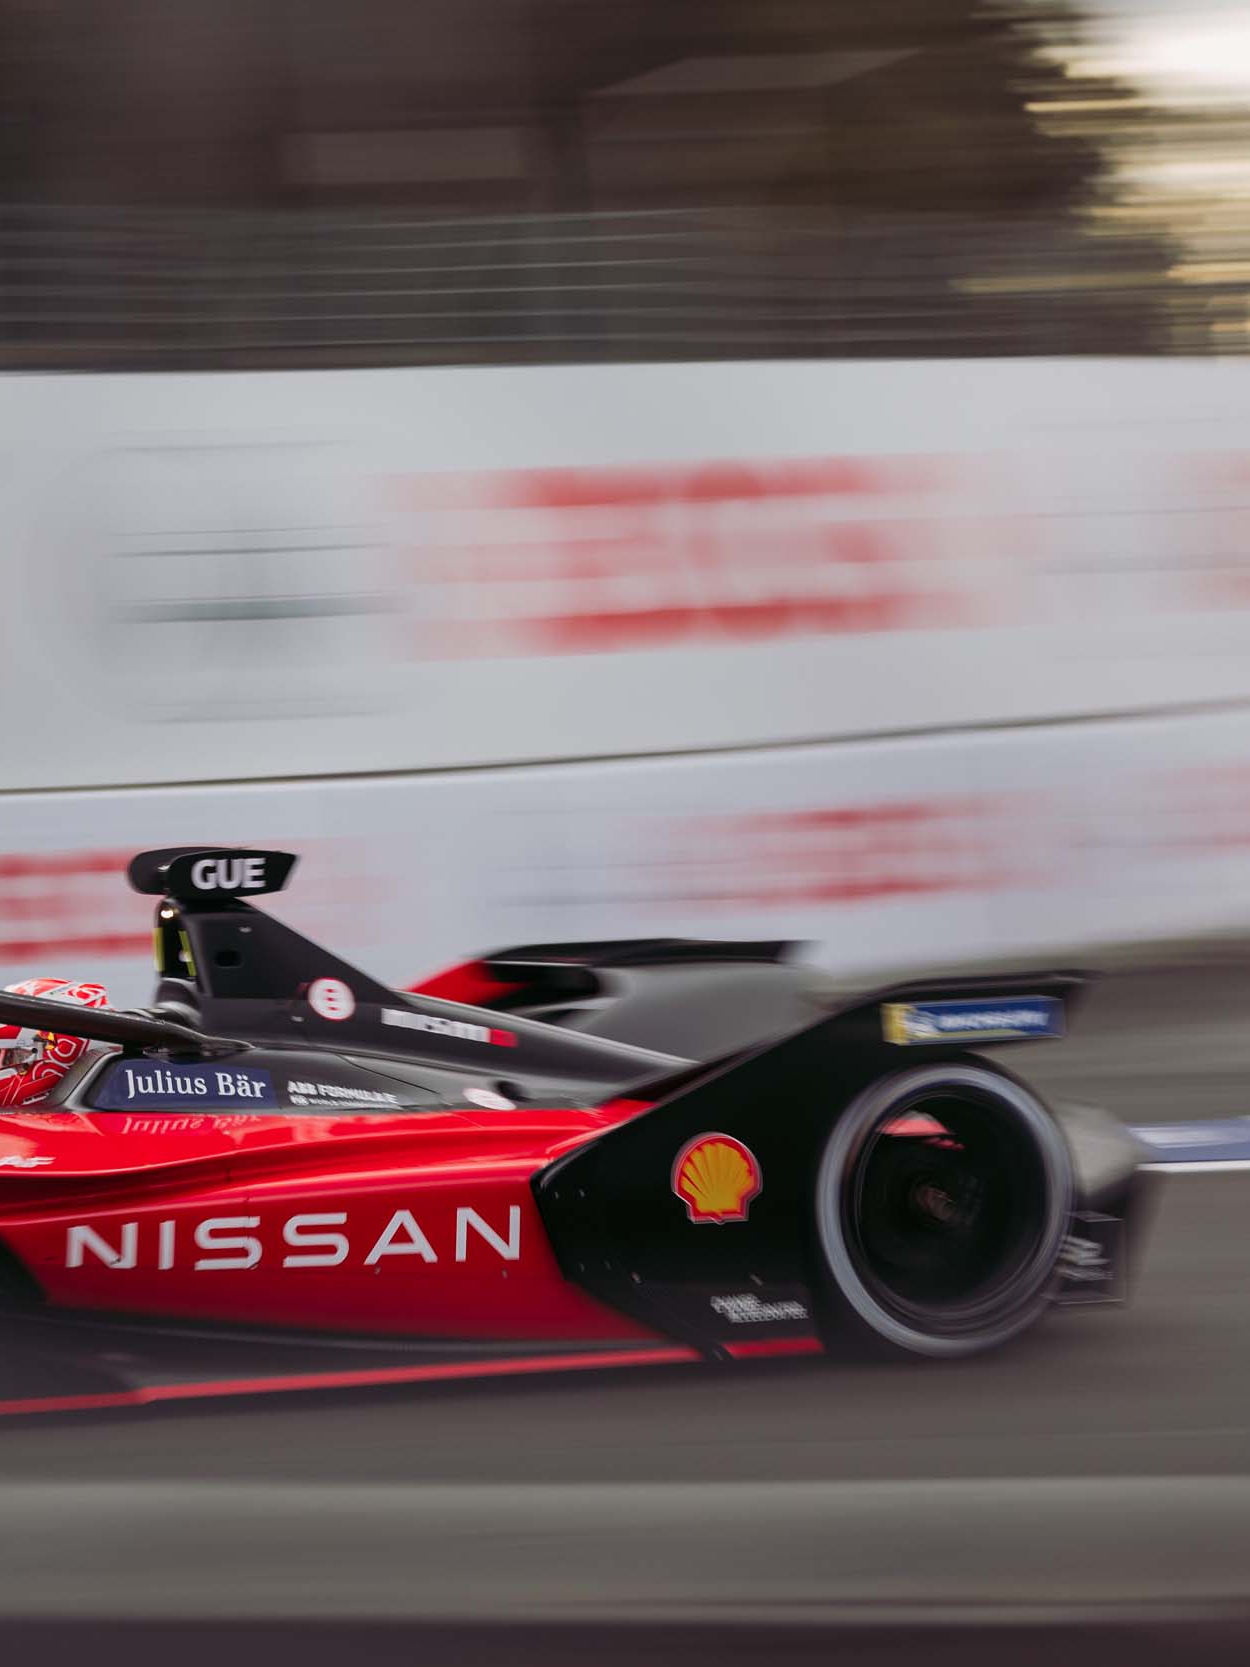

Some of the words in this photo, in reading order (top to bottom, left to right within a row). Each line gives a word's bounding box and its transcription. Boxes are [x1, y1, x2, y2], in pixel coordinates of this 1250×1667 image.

[191, 857, 266, 890] GUE
[124, 1069, 208, 1099] Julius
[214, 1072, 267, 1098] Bär
[65, 1204, 521, 1271] NISSAN
